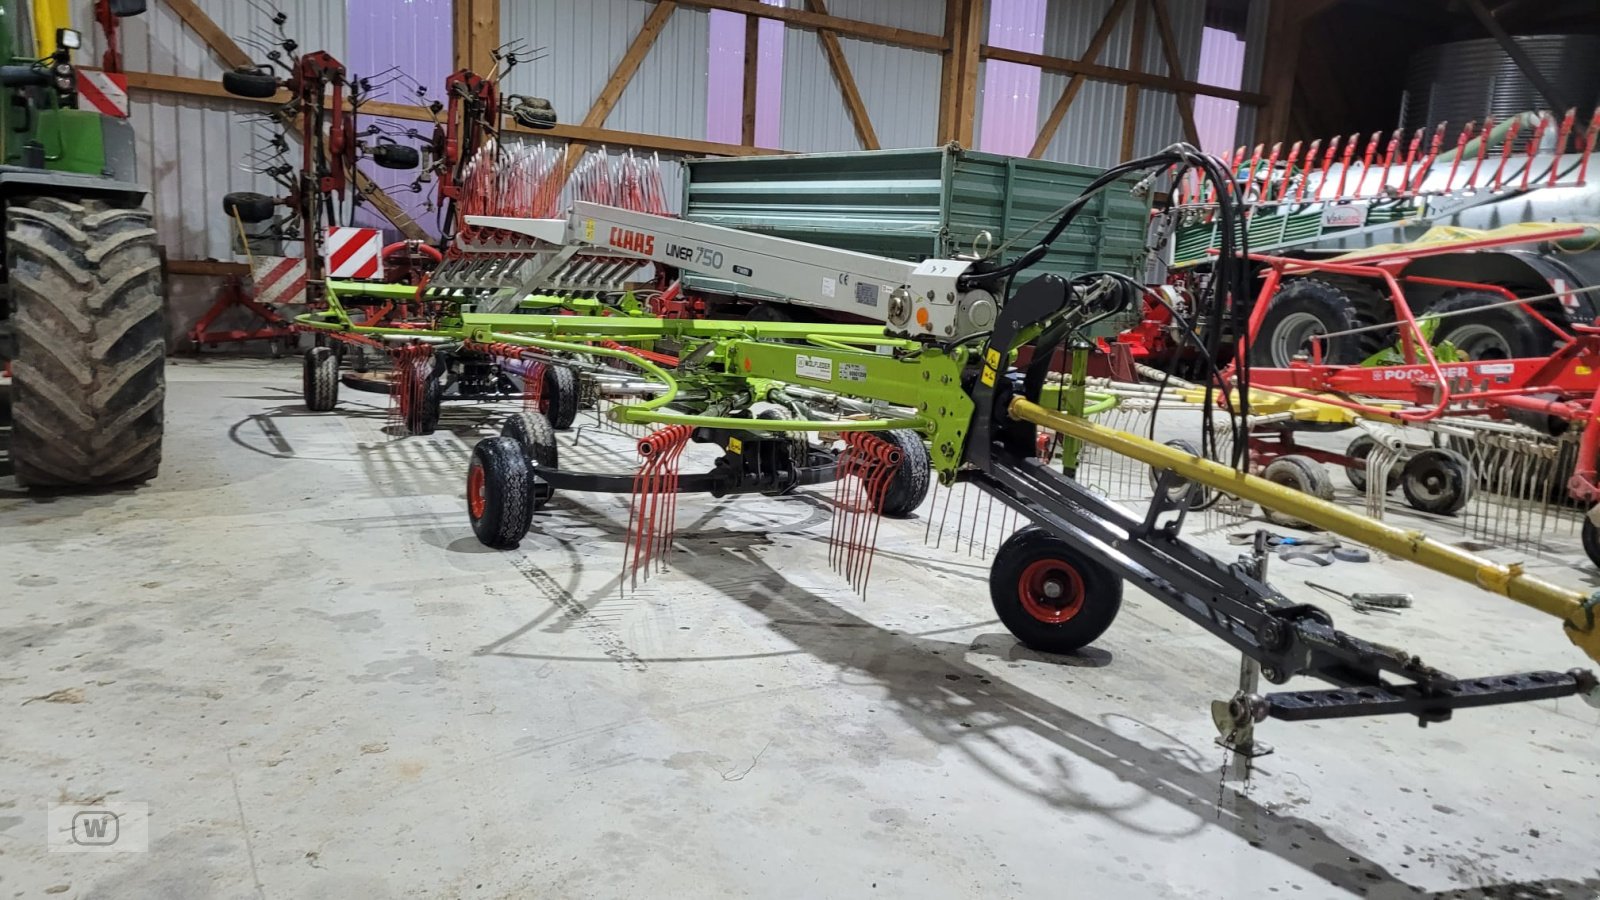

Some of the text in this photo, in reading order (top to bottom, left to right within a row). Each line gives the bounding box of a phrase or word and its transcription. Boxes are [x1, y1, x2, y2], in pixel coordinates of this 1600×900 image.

[609, 226, 655, 256] CLAAS
[665, 242, 724, 270] LINER 750
